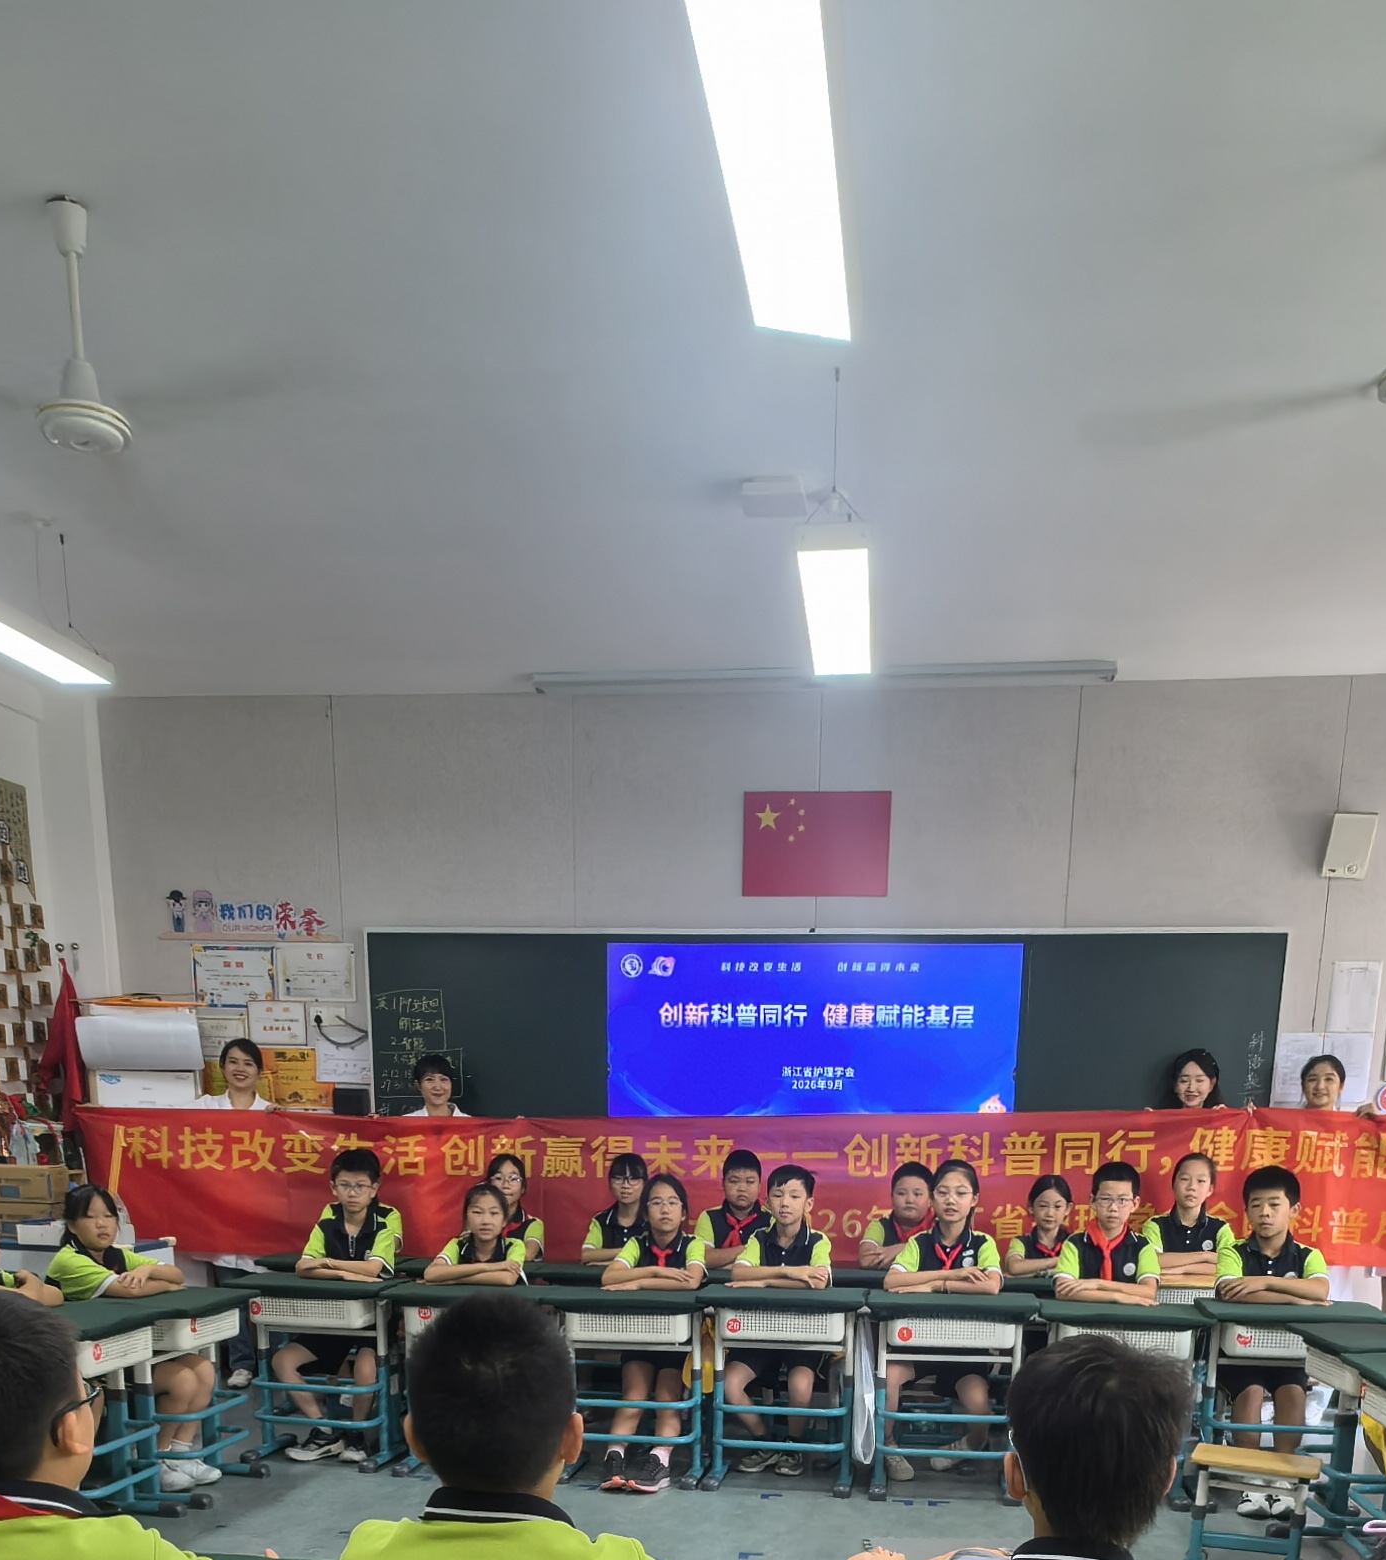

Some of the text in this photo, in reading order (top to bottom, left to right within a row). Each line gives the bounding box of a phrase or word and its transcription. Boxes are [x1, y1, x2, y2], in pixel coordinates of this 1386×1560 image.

[658, 1002, 976, 1030] 创新科普同行 健康赋能基层
[781, 1066, 855, 1078] 浙江省护理学会
